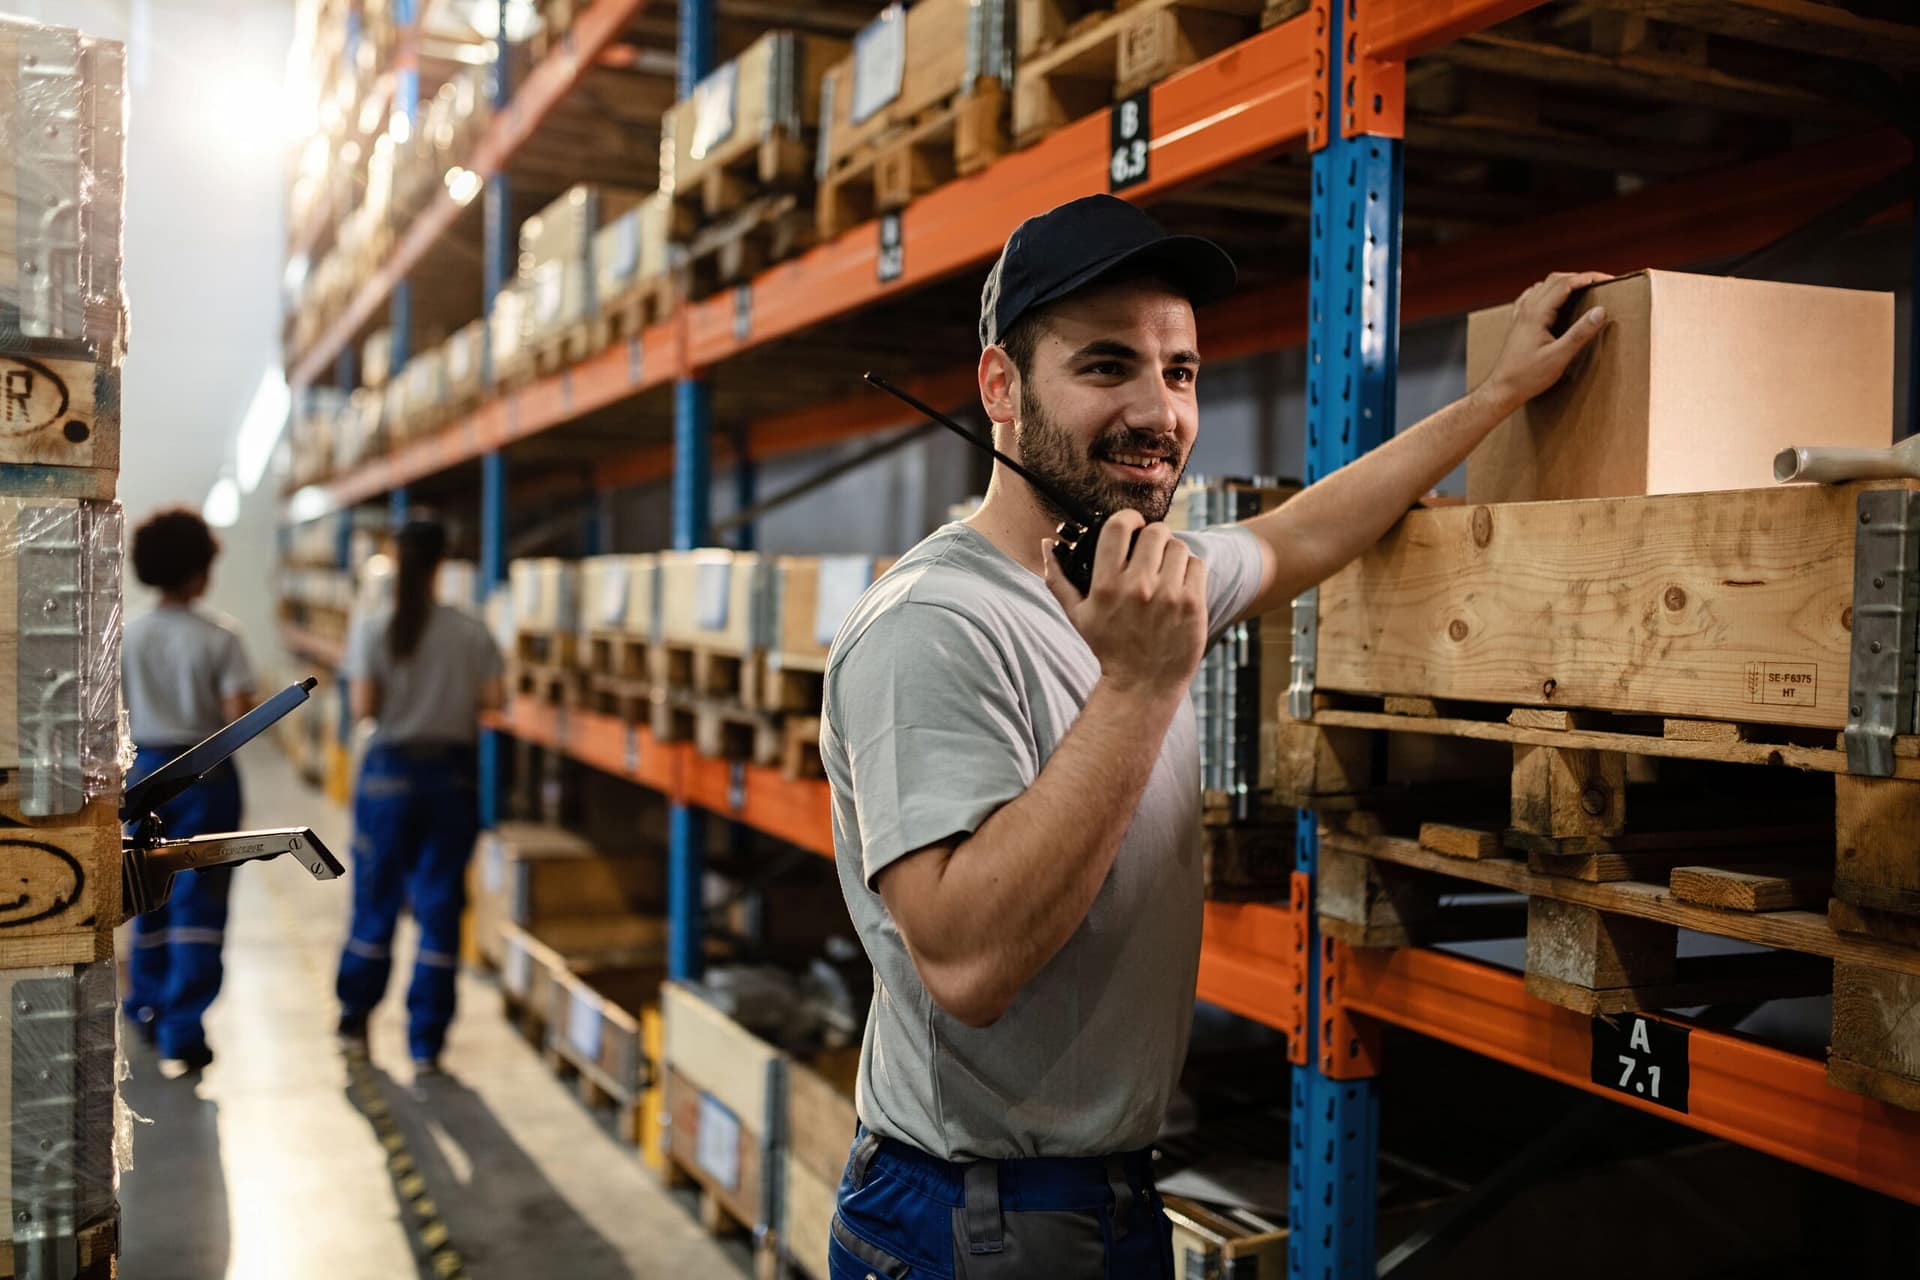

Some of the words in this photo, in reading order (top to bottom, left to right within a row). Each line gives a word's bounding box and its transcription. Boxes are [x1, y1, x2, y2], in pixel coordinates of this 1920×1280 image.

[1121, 101, 1138, 138] B
[1768, 673, 1812, 684] SE-F6375
[1782, 688, 1796, 698] HT
[1630, 1018, 1651, 1054] A
[1618, 1054, 1661, 1098] 7.1
